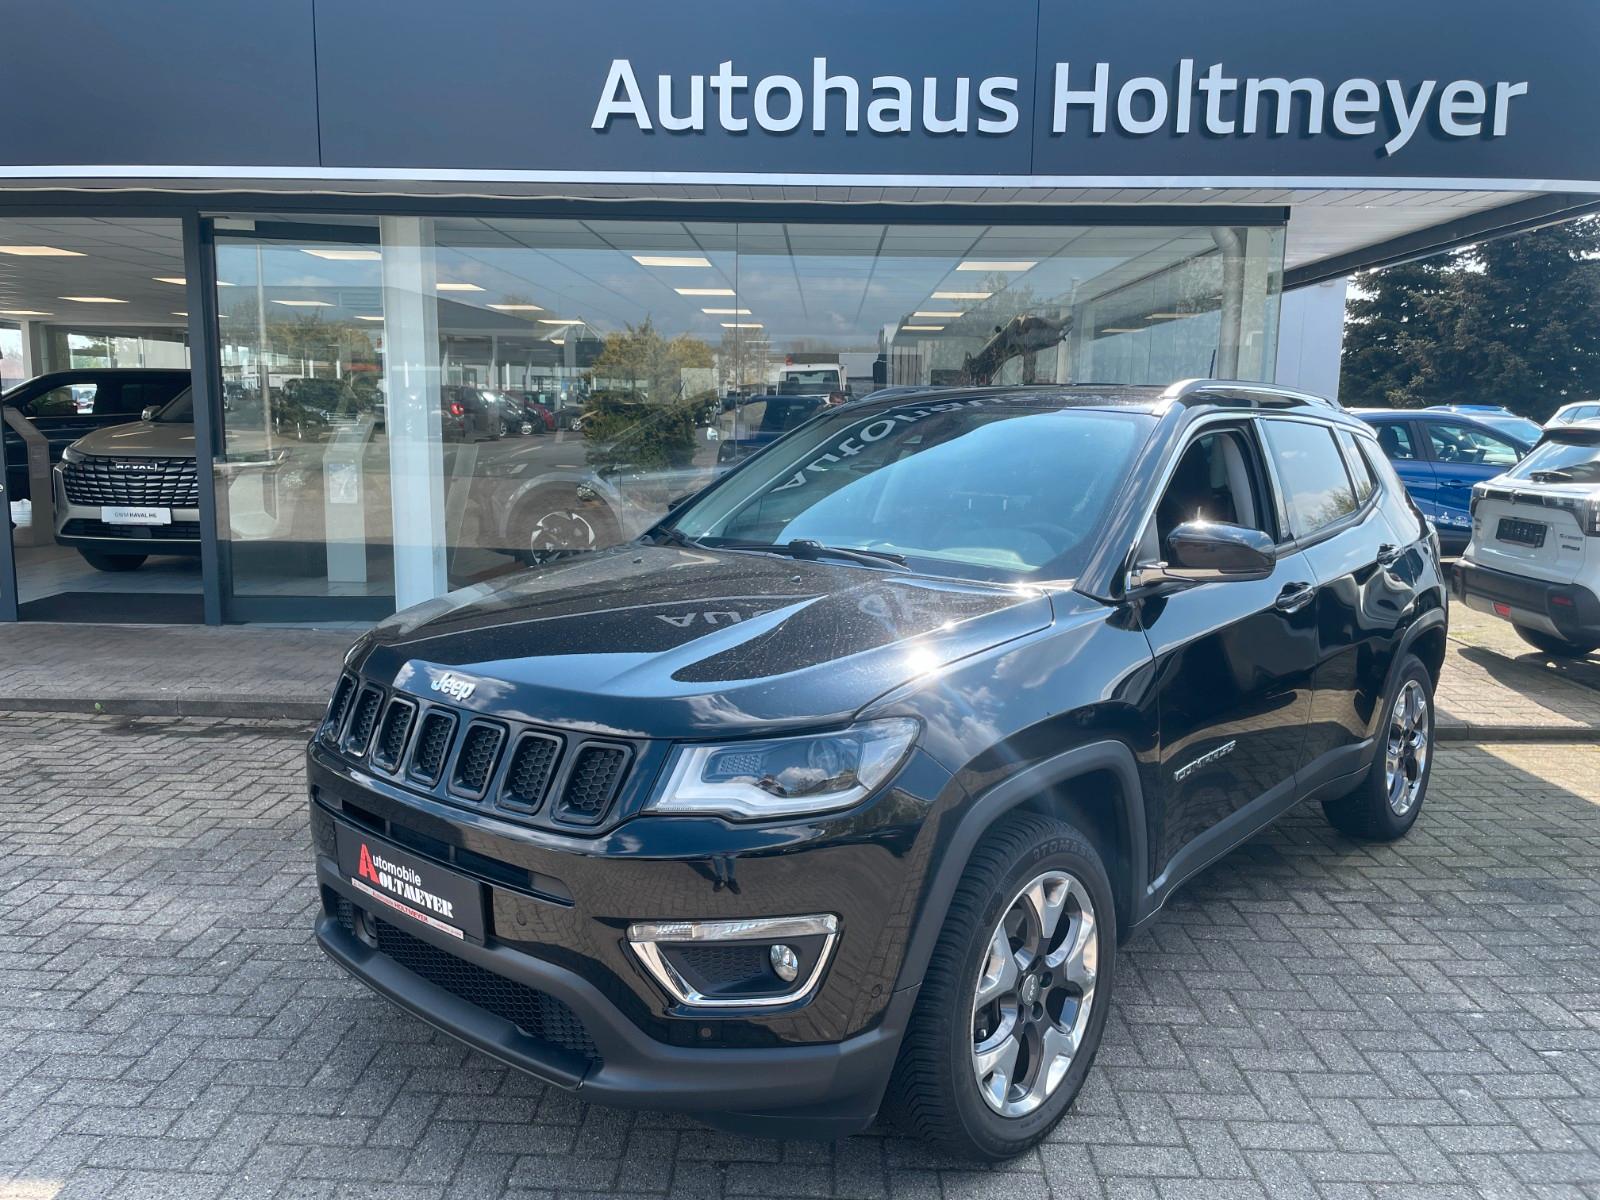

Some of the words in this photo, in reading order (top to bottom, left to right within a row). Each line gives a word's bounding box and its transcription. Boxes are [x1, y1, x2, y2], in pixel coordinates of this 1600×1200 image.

[591, 57, 1020, 134] Autohaus
[1052, 58, 1529, 157] Holtmeyer
[430, 672, 476, 702] Jeep
